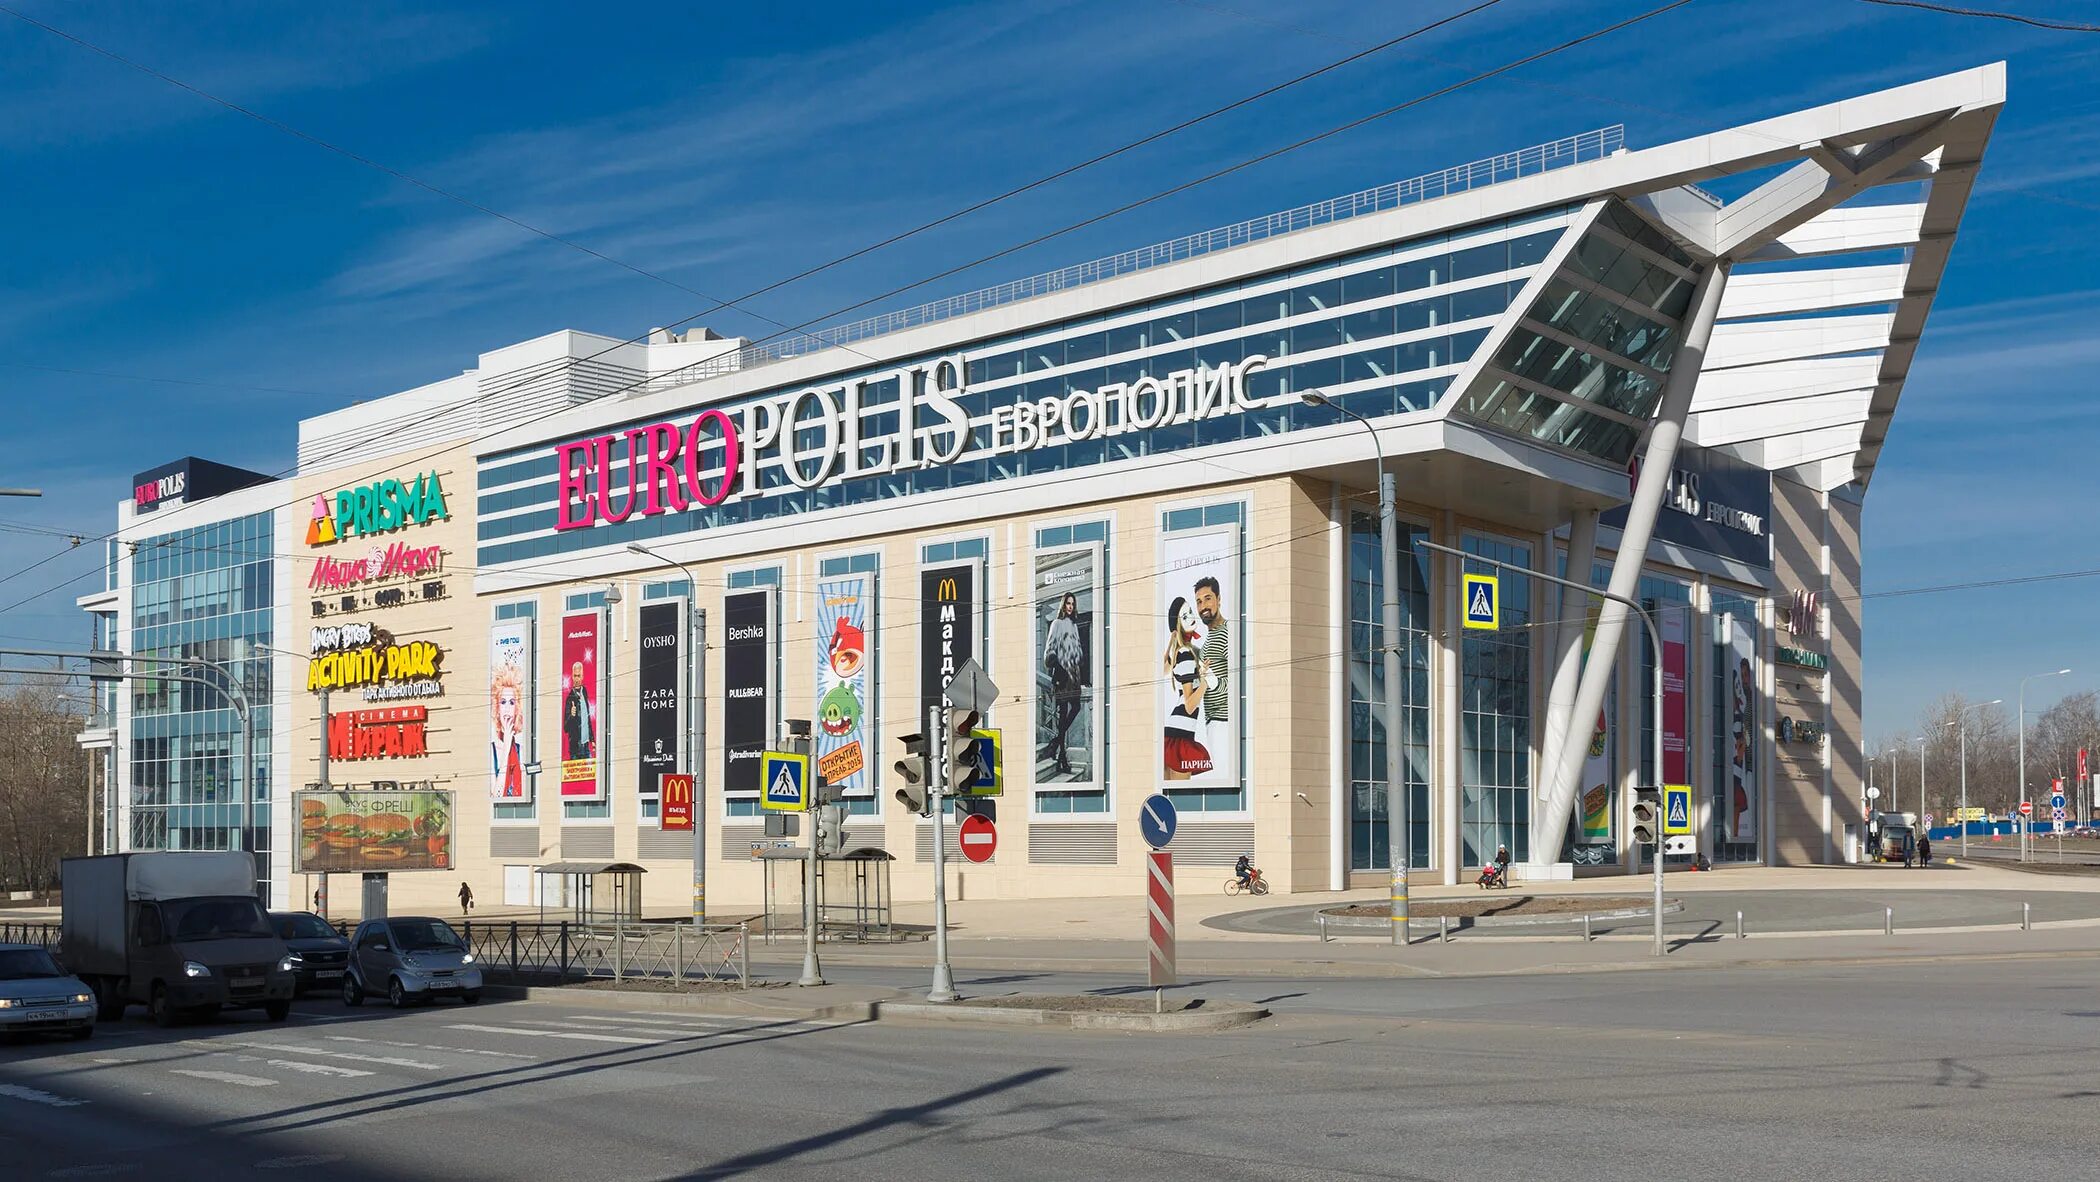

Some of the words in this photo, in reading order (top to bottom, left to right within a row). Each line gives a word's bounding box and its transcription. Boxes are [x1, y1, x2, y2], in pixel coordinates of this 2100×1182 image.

[991, 354, 1268, 453] ЕВРОПОЛИС
[554, 352, 970, 531] EUROPOLIS
[335, 469, 446, 539] PRISMA
[311, 626, 341, 653] ANGRY
[341, 622, 372, 649] BIRDS
[729, 626, 764, 640] Bershka
[643, 634, 675, 648] OYSHO
[307, 648, 384, 692] ACTIVITY
[386, 640, 437, 680] PARK
[362, 688, 378, 700] ПАРК
[643, 688, 675, 699] ZARA
[729, 687, 763, 698] PULL&BEAR
[643, 700, 675, 709] HOME
[360, 709, 419, 721] CINEMA
[821, 744, 858, 772] ОТКРЫТИЕ
[1181, 760, 1213, 769] ПАРИЖ
[824, 764, 847, 781] ПРЕЛЬ
[371, 800, 414, 813] ФРЕШ
